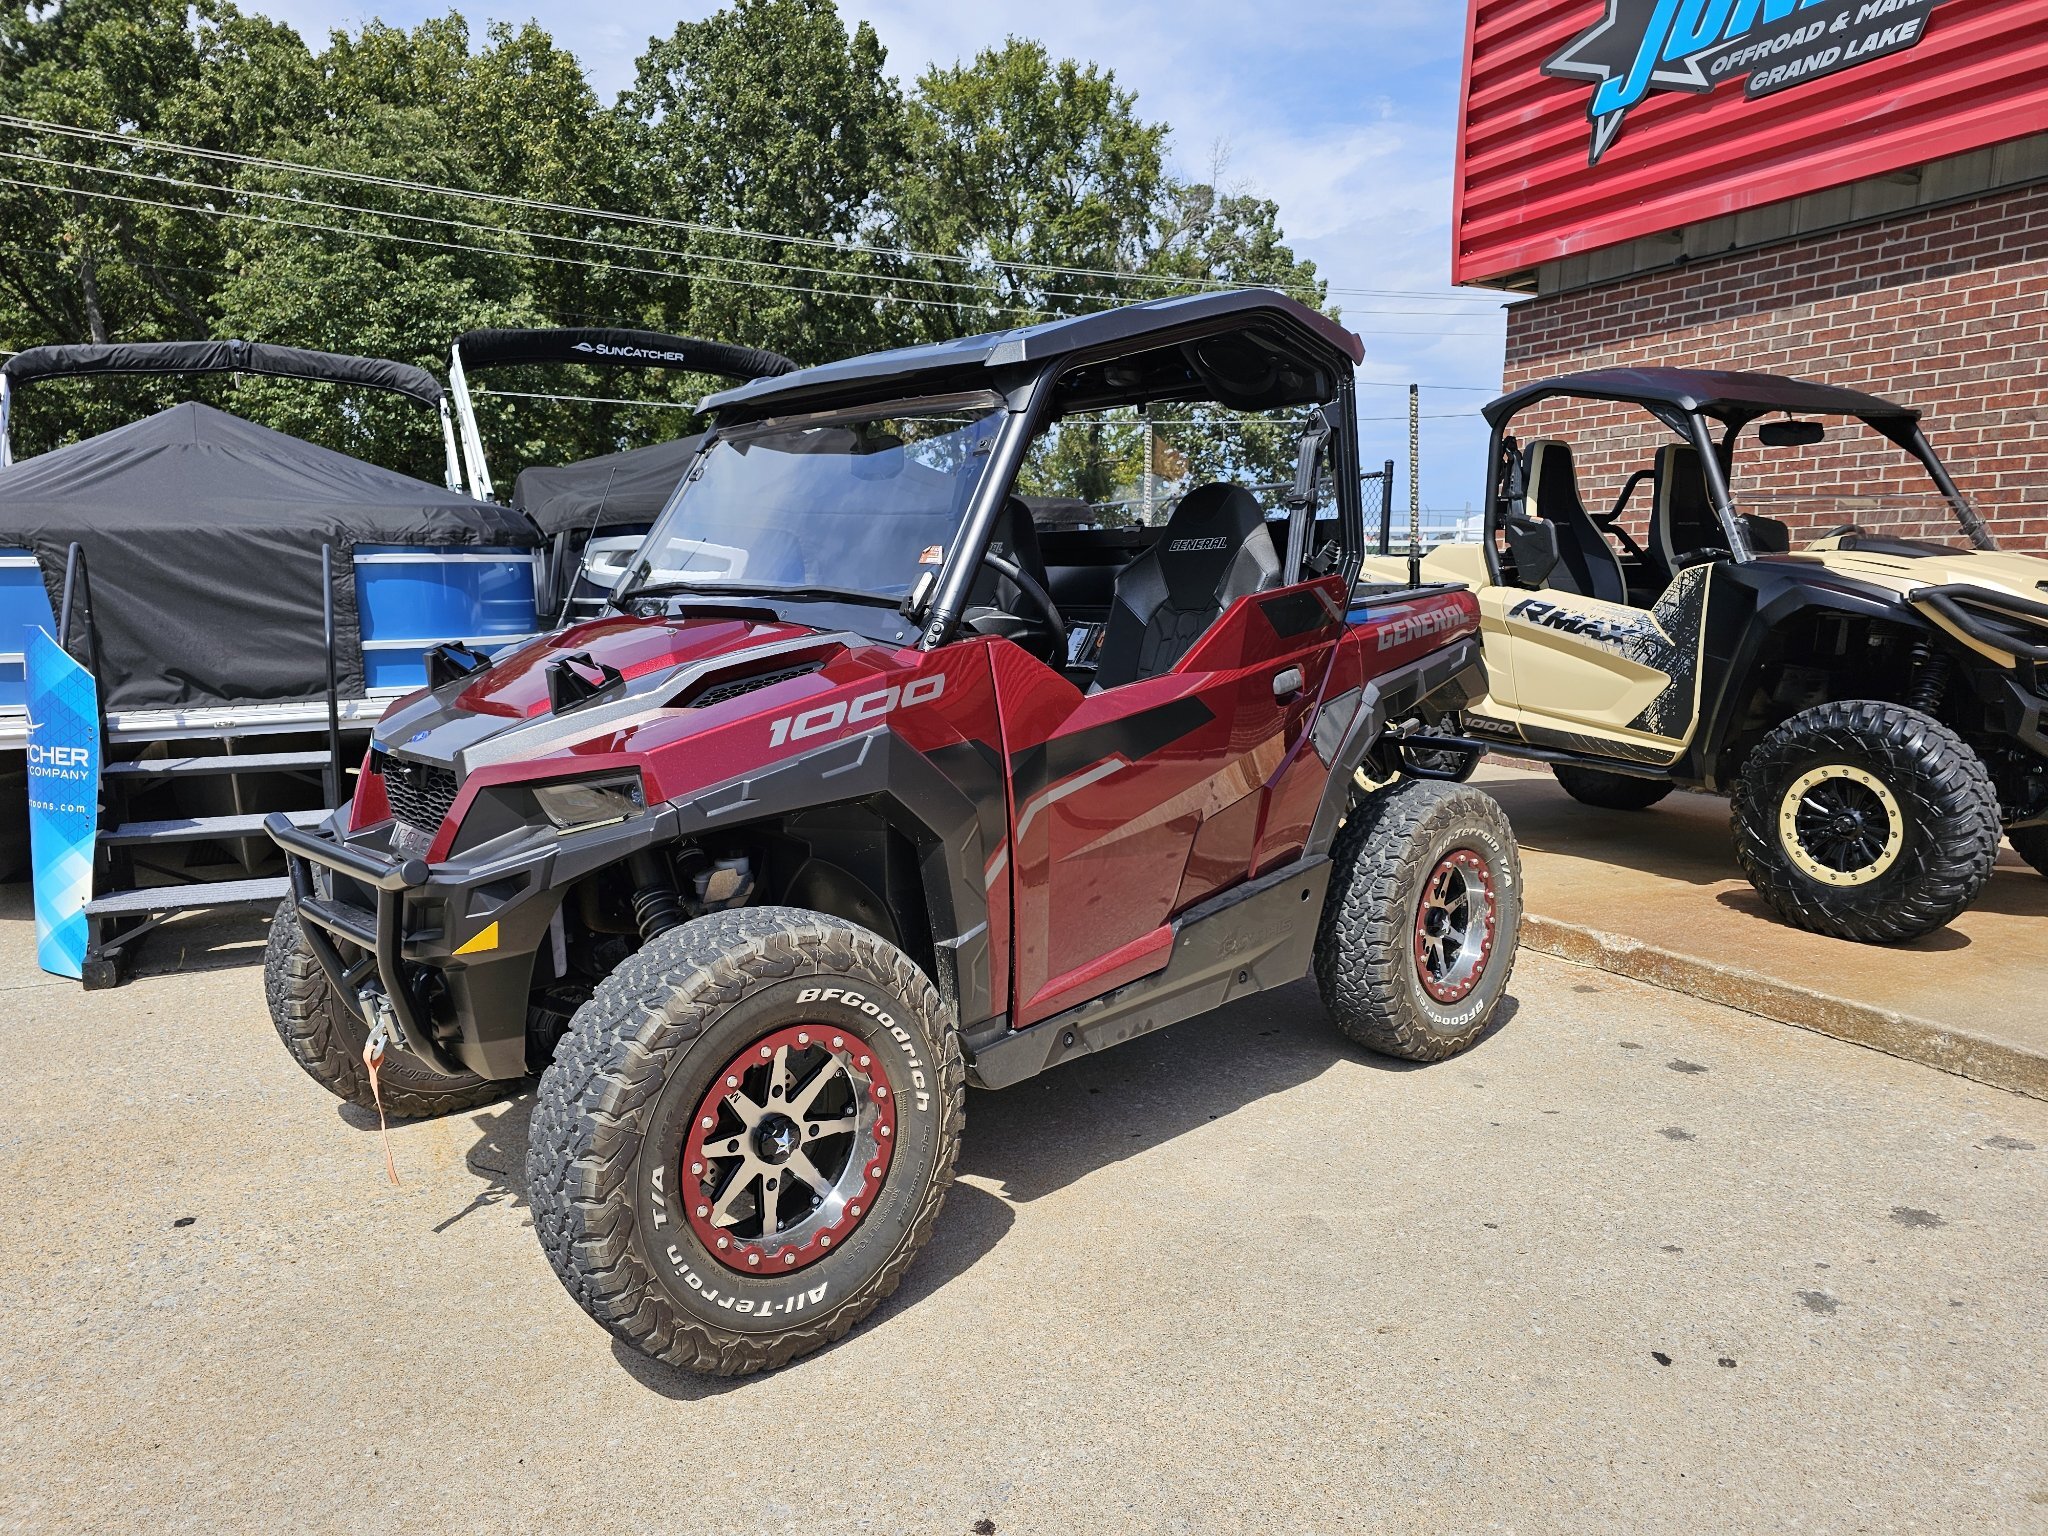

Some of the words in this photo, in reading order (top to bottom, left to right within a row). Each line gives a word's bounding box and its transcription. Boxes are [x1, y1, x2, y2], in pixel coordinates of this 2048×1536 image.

[1710, 21, 1822, 76] OFFROAD
[1828, 10, 1851, 34] &
[1750, 49, 1841, 91] GRAND
[1843, 17, 1921, 60] LAKE
[1168, 536, 1228, 552] GENERAL
[1376, 603, 1470, 652] GENERAL
[769, 672, 946, 749] 1000
[1464, 717, 1515, 734] 1000
[29, 765, 89, 780] COMPANY
[1500, 855, 1513, 889] T/A
[1415, 984, 1484, 1025] BFGoodrich
[796, 987, 929, 1112] BFGoodrich
[650, 1164, 666, 1231] T/A
[665, 1243, 829, 1317] All-Terrain
